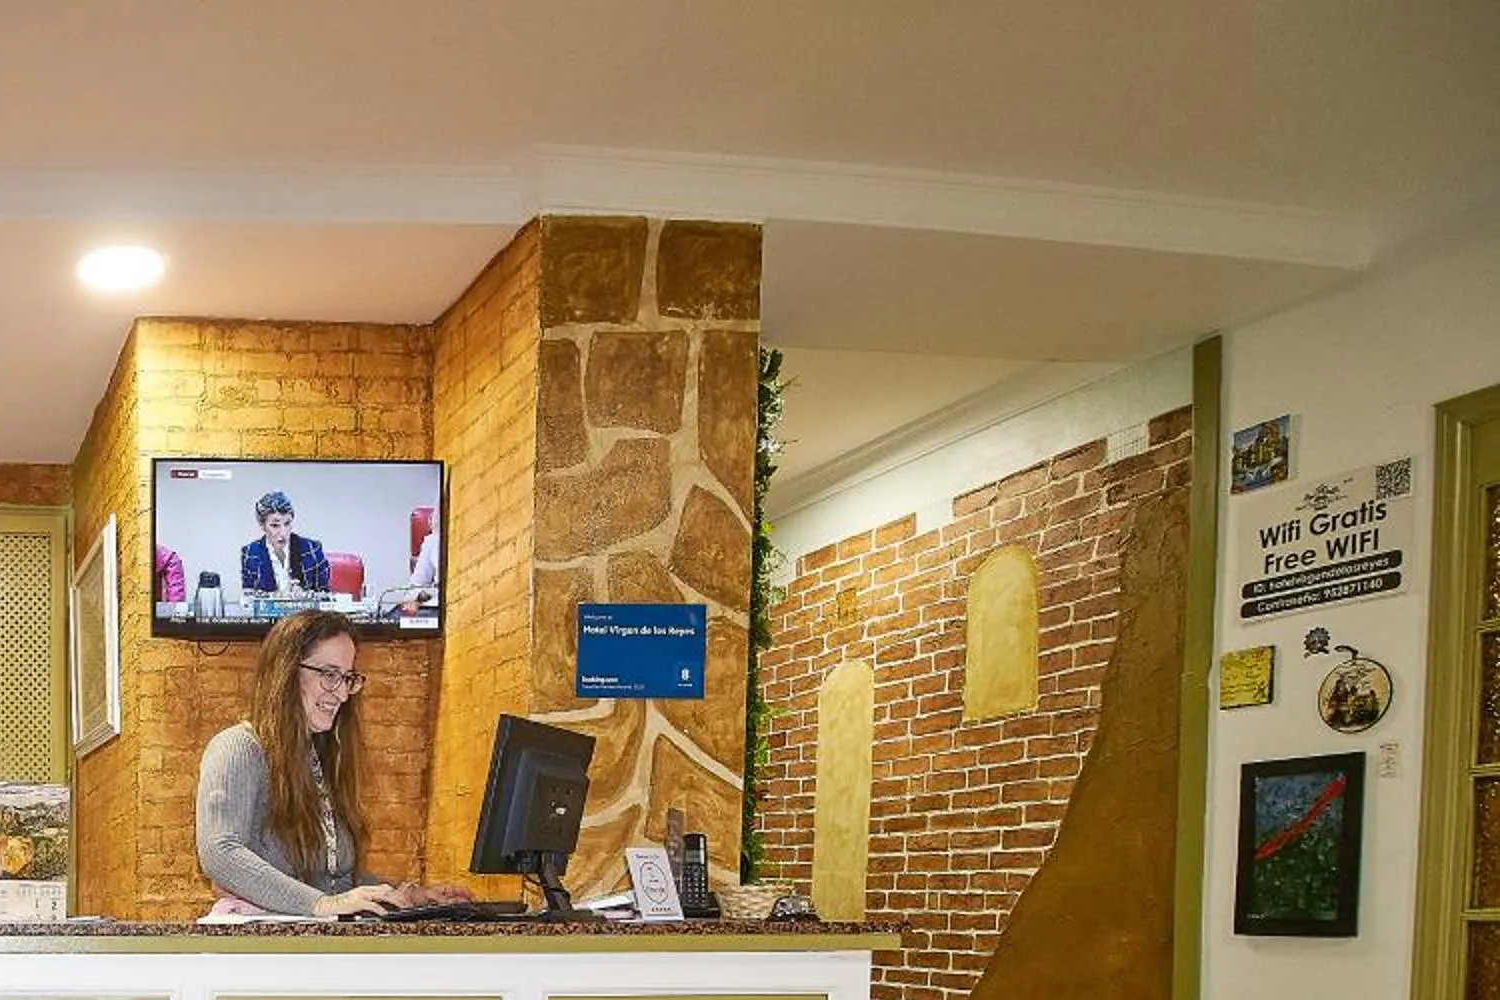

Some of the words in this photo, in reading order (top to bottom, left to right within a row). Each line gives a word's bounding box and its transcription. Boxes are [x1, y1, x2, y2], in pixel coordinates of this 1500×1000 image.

[1259, 519, 1301, 549] Wifi
[1309, 499, 1388, 536] Gratis
[1264, 549, 1317, 575] Free
[1326, 527, 1380, 561] WIFI
[583, 625, 607, 636] Hotel
[609, 625, 639, 637] Virgen
